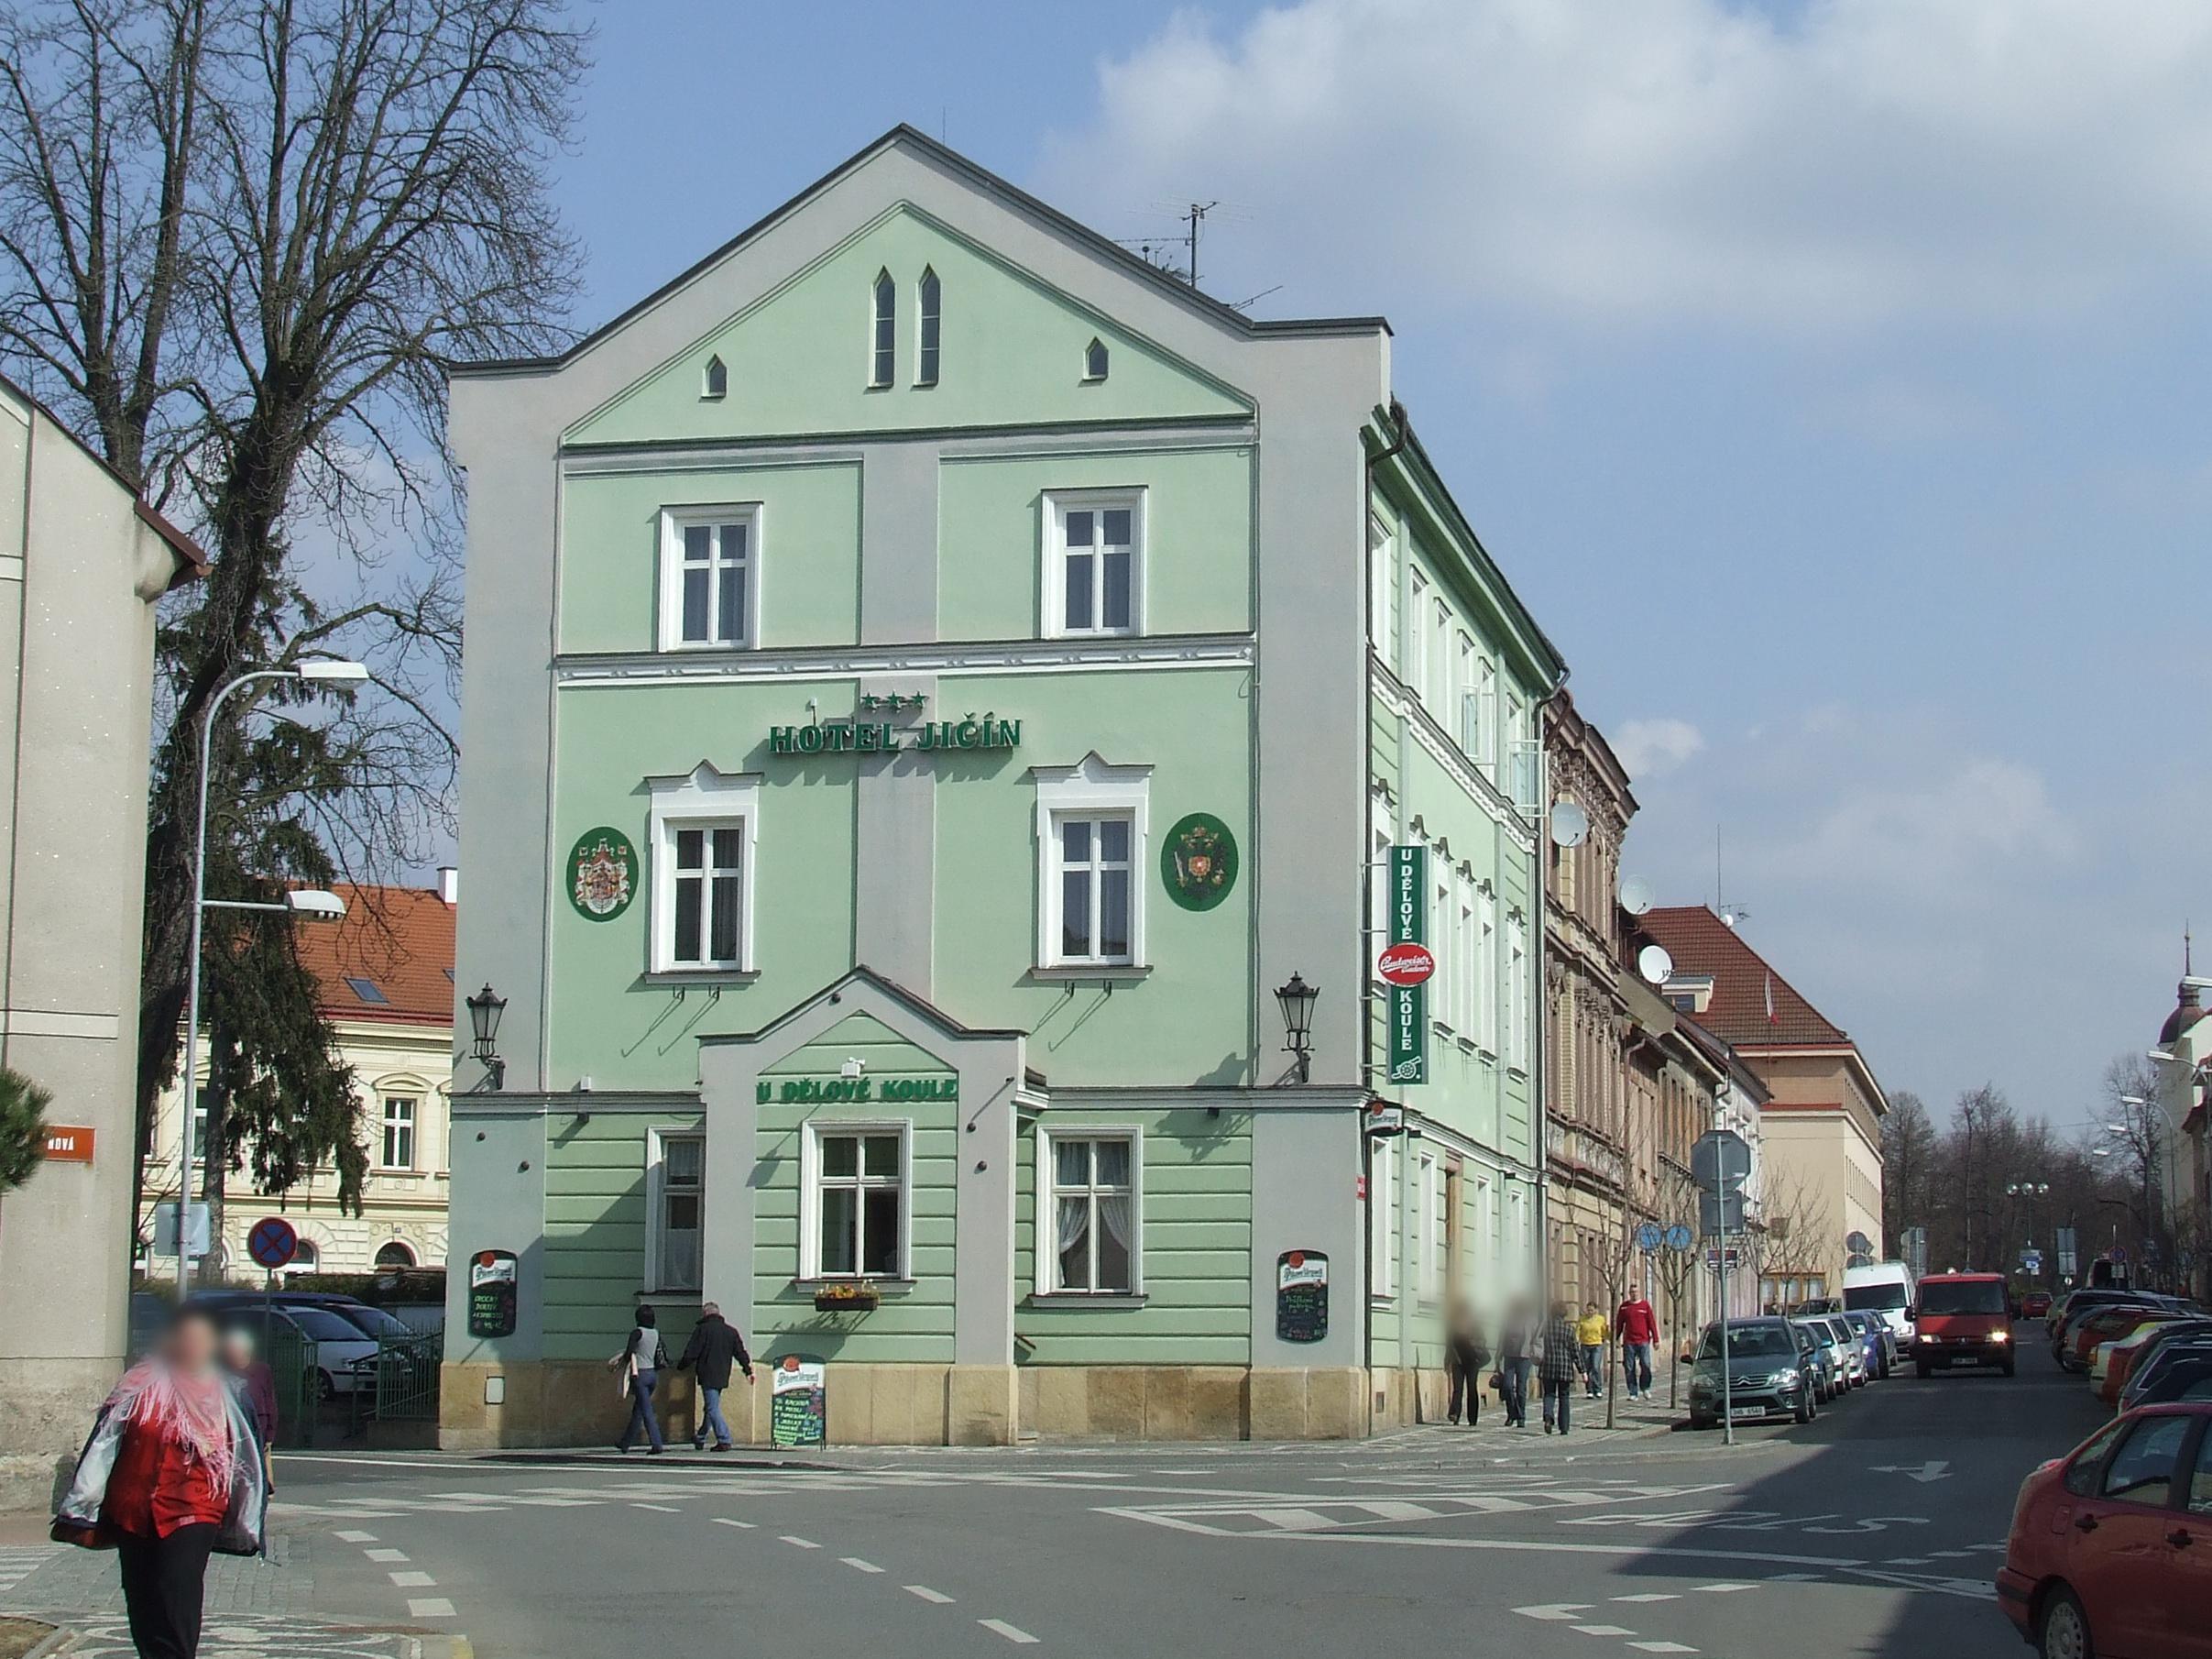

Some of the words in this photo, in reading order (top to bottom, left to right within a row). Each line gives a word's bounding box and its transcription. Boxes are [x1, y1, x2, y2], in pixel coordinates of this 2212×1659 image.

[769, 722, 900, 753] HOTEL
[917, 711, 1023, 749] JIČÍN
[1401, 849, 1412, 861] U
[1399, 990, 1413, 1050] KOULE
[757, 1082, 772, 1101] U
[781, 1077, 871, 1101] DĚLOVÉ
[881, 1080, 958, 1101] KOULE
[1556, 1510, 1931, 1533] STOP
